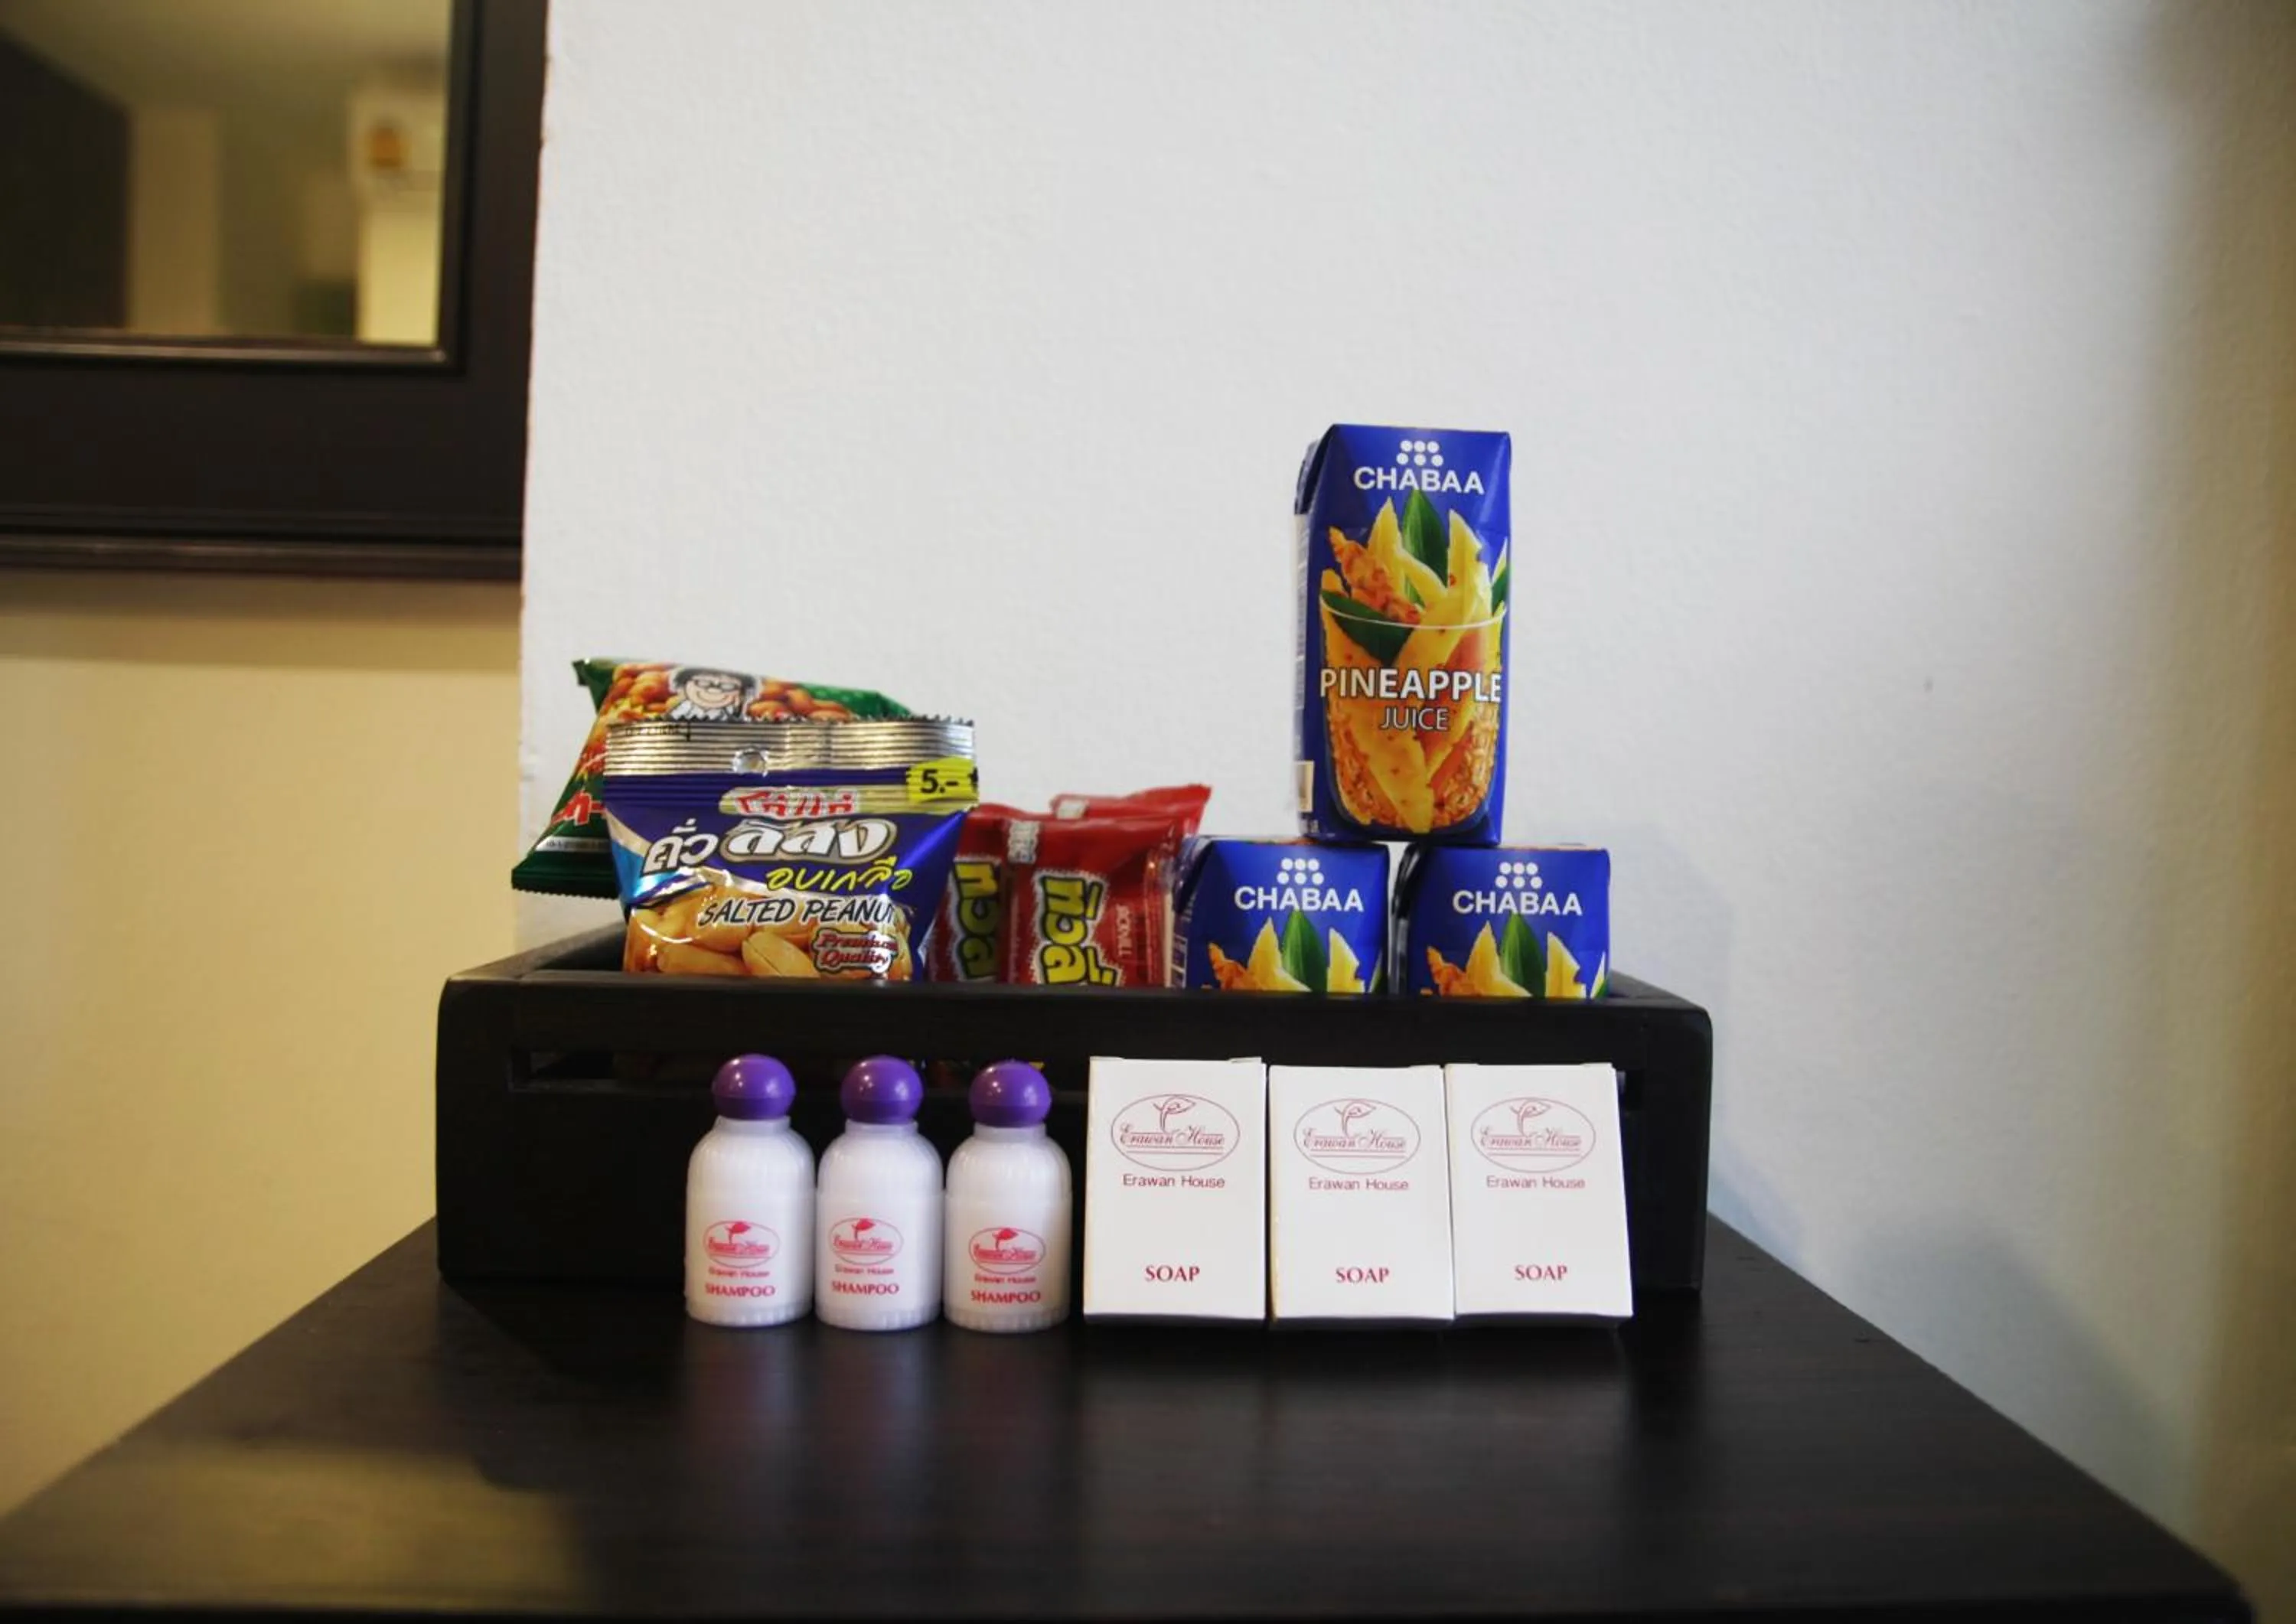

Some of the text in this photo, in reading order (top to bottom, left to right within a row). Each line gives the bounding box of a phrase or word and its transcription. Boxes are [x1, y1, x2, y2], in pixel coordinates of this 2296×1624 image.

[1353, 466, 1485, 494] CHABAA
[1319, 667, 1502, 703] PINEAPPLE
[1380, 706, 1450, 732] JUICE
[1234, 885, 1365, 912] CHABAA
[1453, 890, 1583, 916] CHABAA
[697, 898, 796, 927] SALTED
[1123, 1173, 1225, 1189] Erawan House
[1309, 1177, 1410, 1191] Erawan House
[1486, 1175, 1586, 1189] Erawan House
[1145, 1265, 1200, 1283] SOAP
[1336, 1267, 1389, 1284] SOAP
[1515, 1264, 1568, 1282] SOAP
[705, 1281, 775, 1298] SHAMPOO
[831, 1280, 900, 1295] SHAMPOO
[970, 1290, 1041, 1304] SHAMPOO
